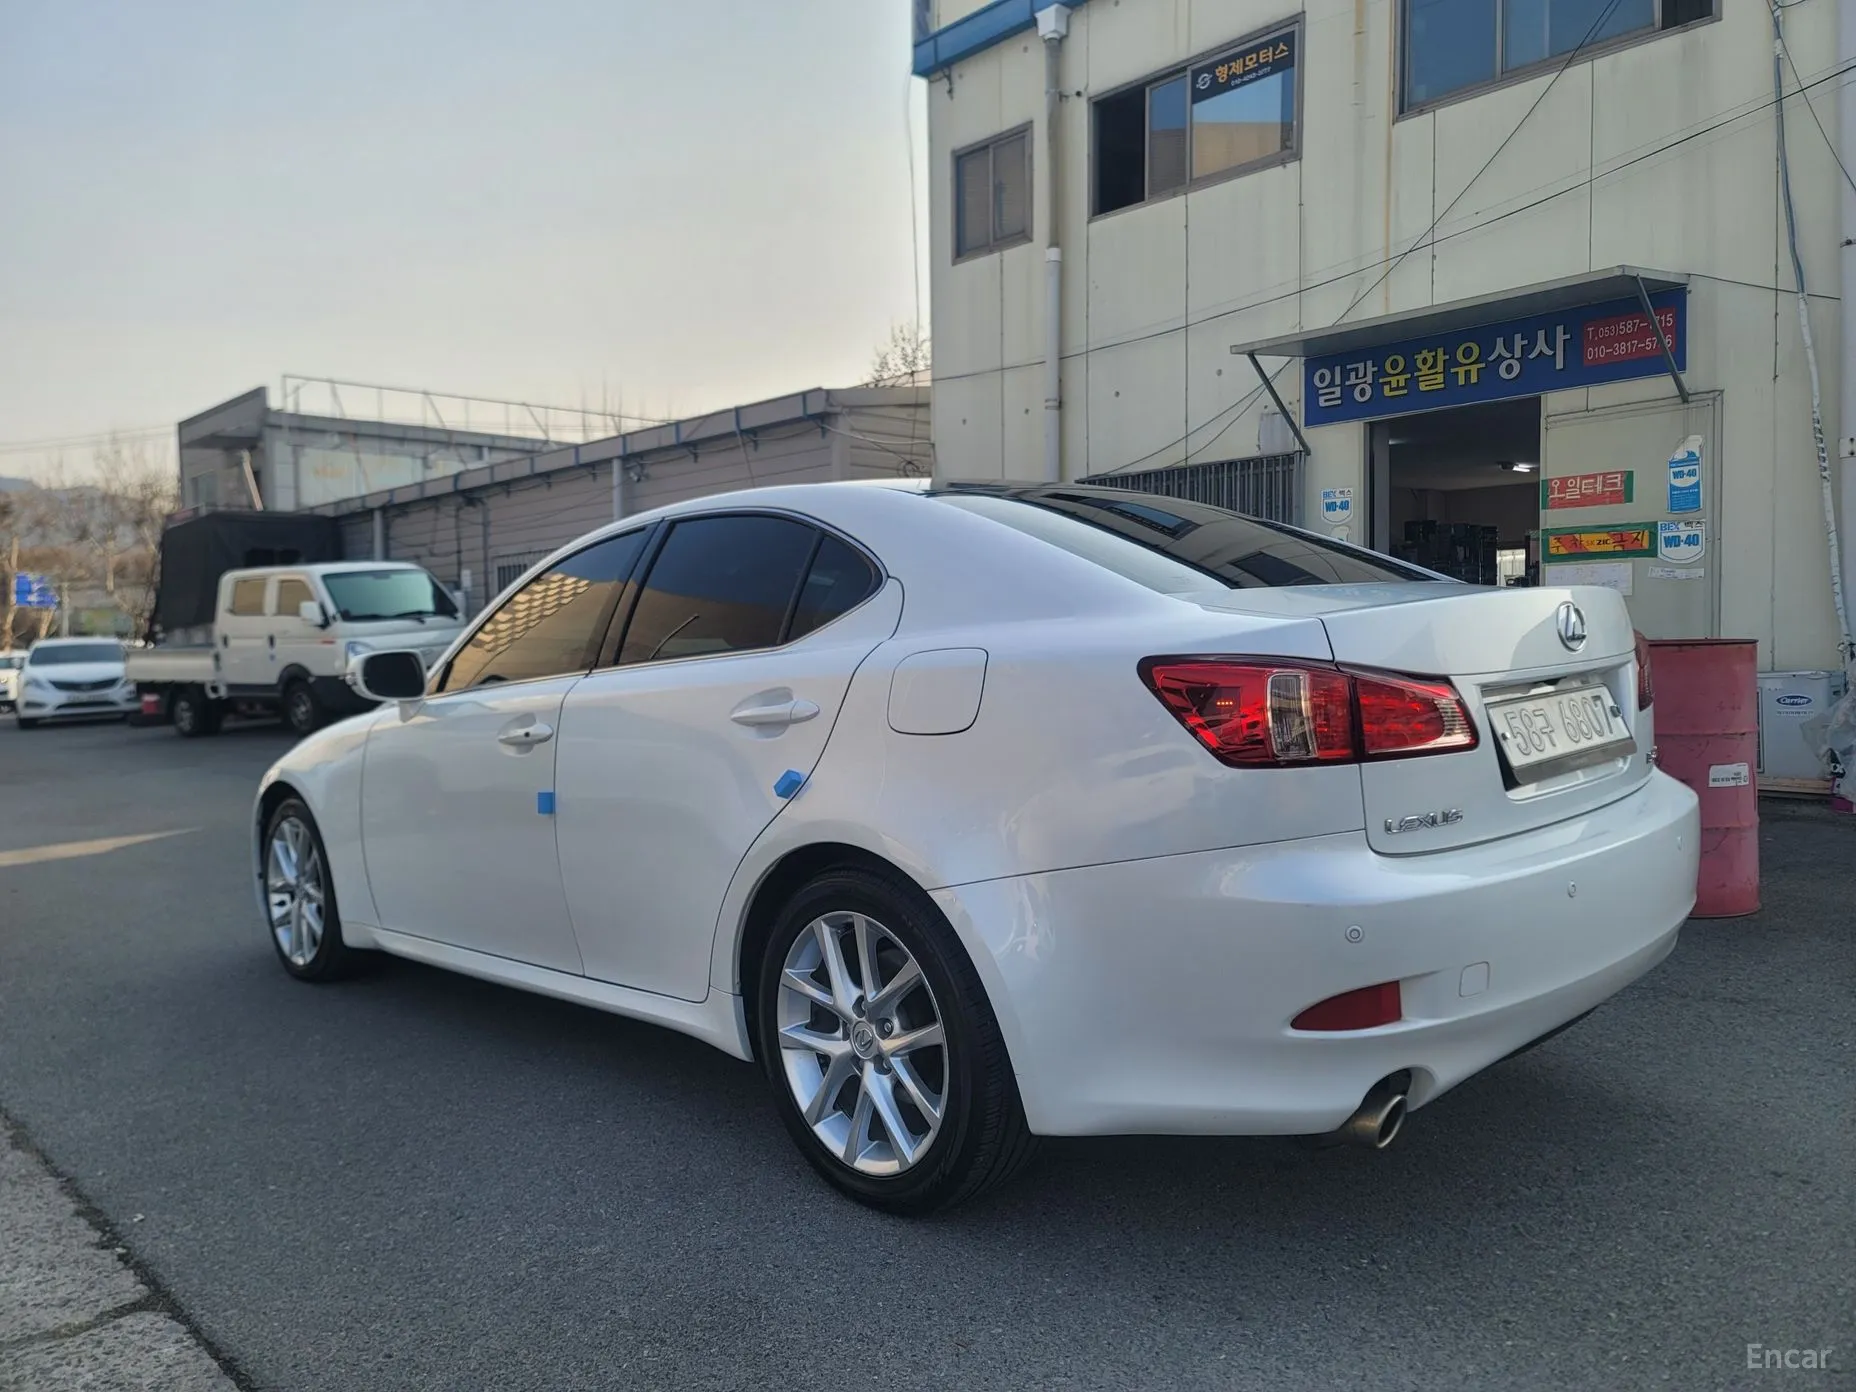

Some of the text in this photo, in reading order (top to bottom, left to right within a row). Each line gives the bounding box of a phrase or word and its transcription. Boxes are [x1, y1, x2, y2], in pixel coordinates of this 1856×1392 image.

[1215, 42, 1289, 83] 형제모터스
[1587, 313, 1673, 341] T.053)587-15
[1587, 334, 1672, 360] 010-3817-576
[1313, 324, 1571, 408] 일광윤활유상사
[1549, 473, 1624, 499] 오일테크
[1672, 468, 1697, 480] WD-40
[1325, 500, 1350, 512] WD-40
[1660, 522, 1680, 531] BEX
[1663, 534, 1700, 548] WD-40
[1780, 697, 1809, 705] Carrier
[1504, 694, 1614, 756] 58구 6807
[1384, 809, 1463, 835] LEXUS
